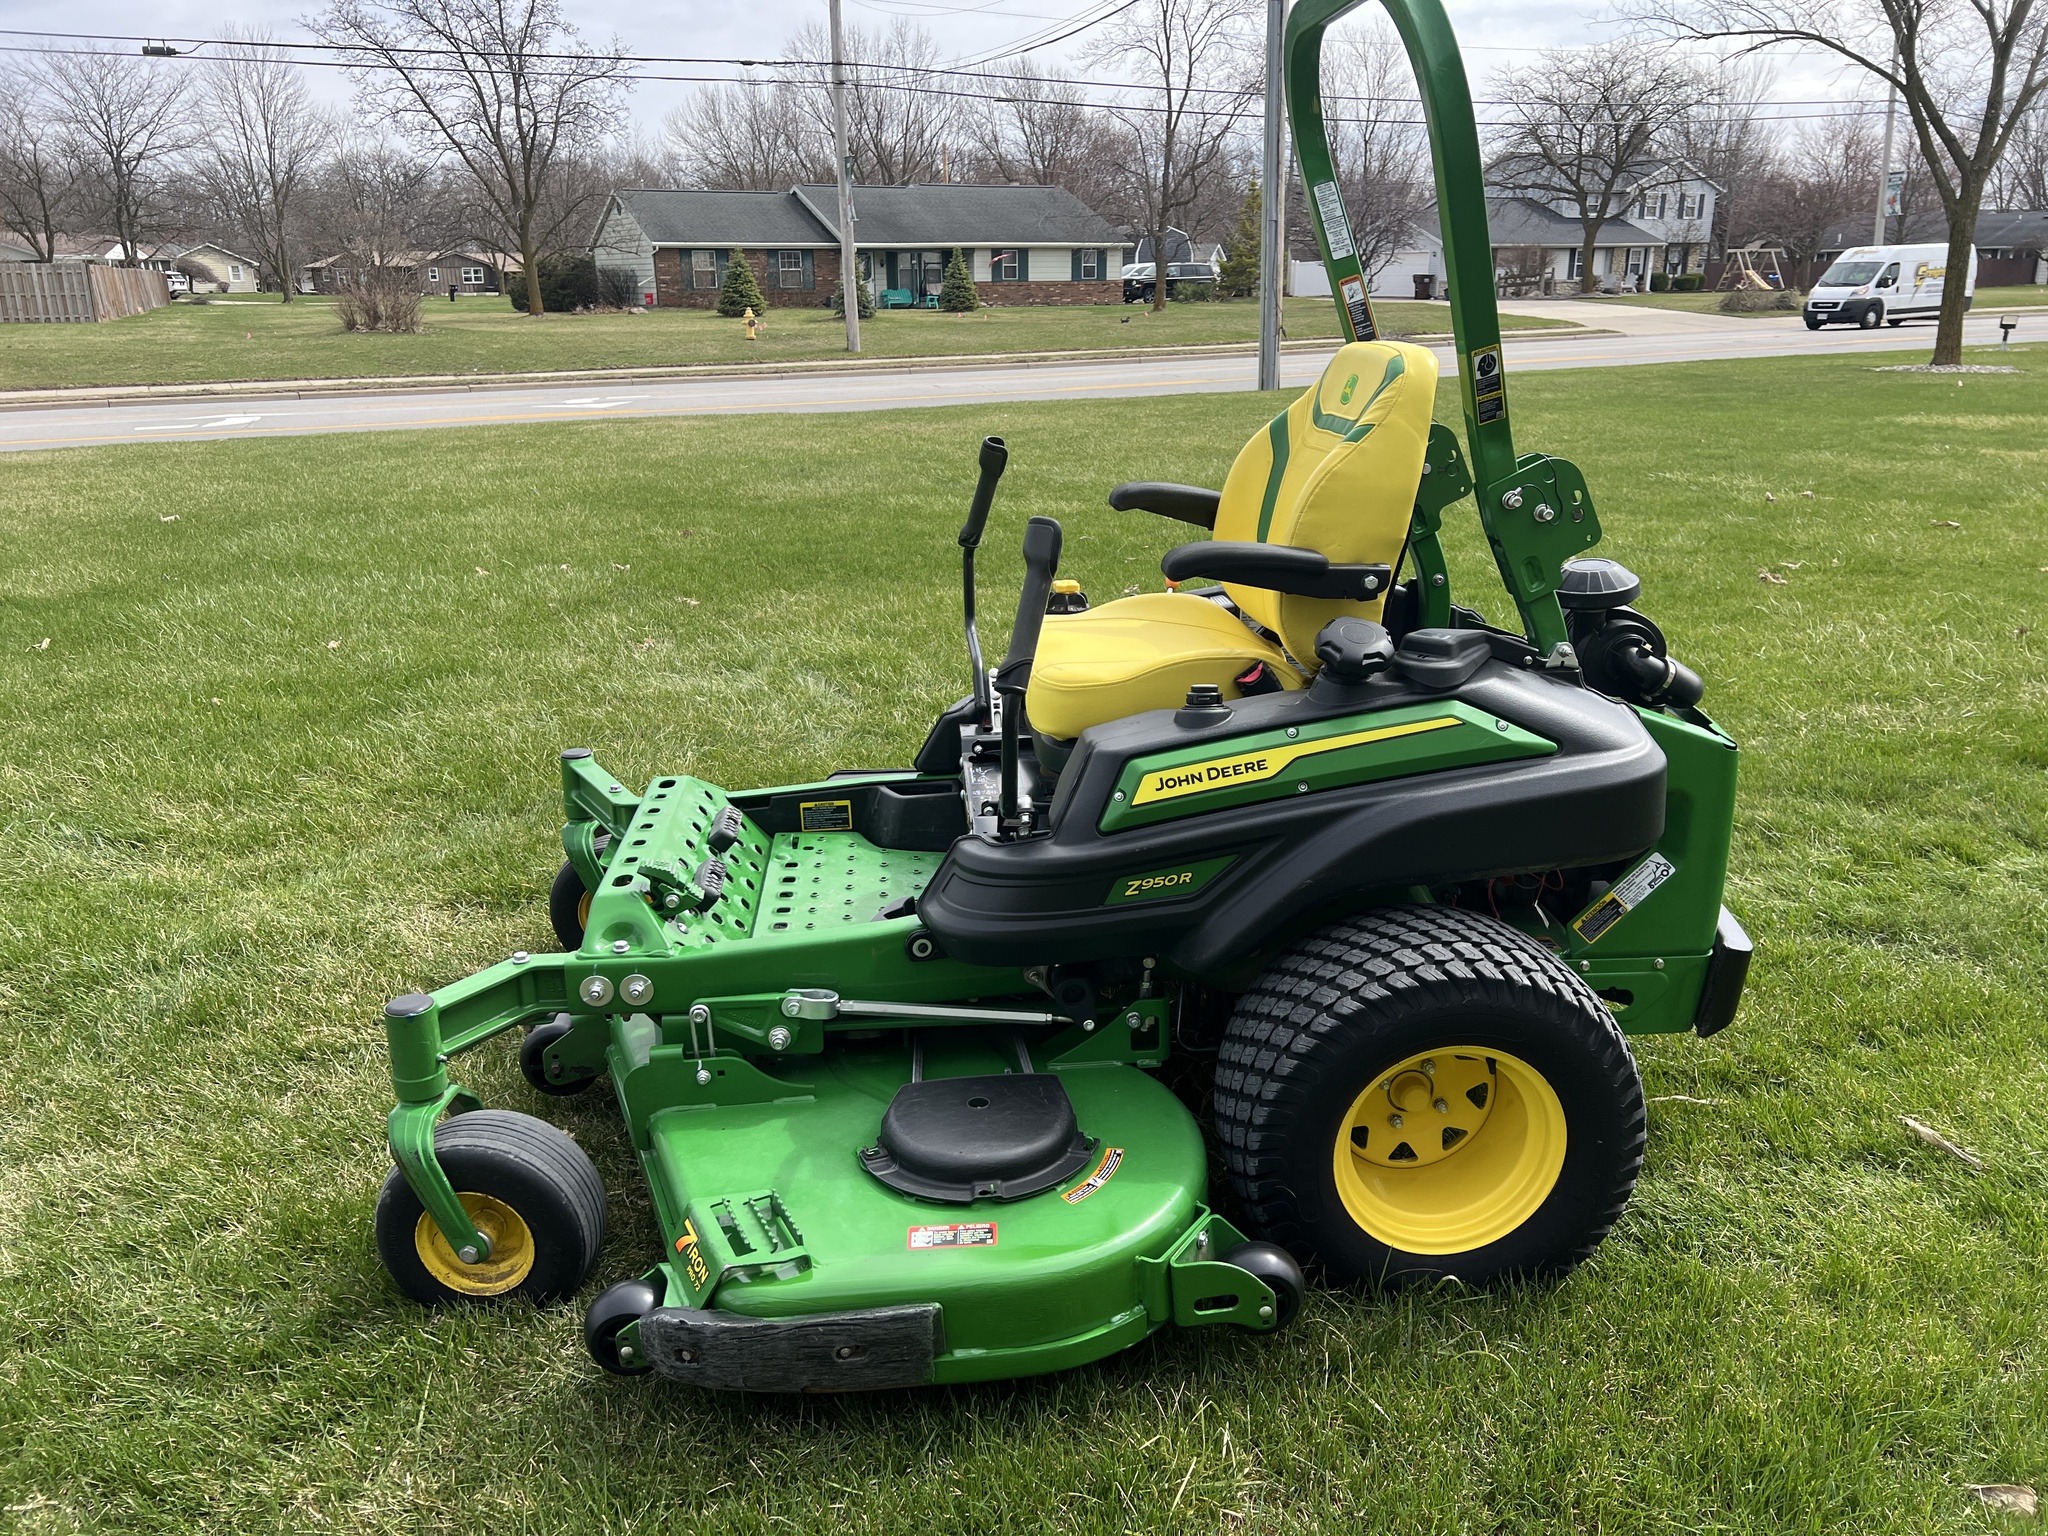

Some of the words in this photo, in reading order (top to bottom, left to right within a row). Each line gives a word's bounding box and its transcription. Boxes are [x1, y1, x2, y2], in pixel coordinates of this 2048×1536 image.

[1155, 771, 1204, 792] JOHN
[1206, 759, 1268, 781] DEERE
[1124, 872, 1193, 896] Z950R
[686, 1265, 697, 1282] PRO
